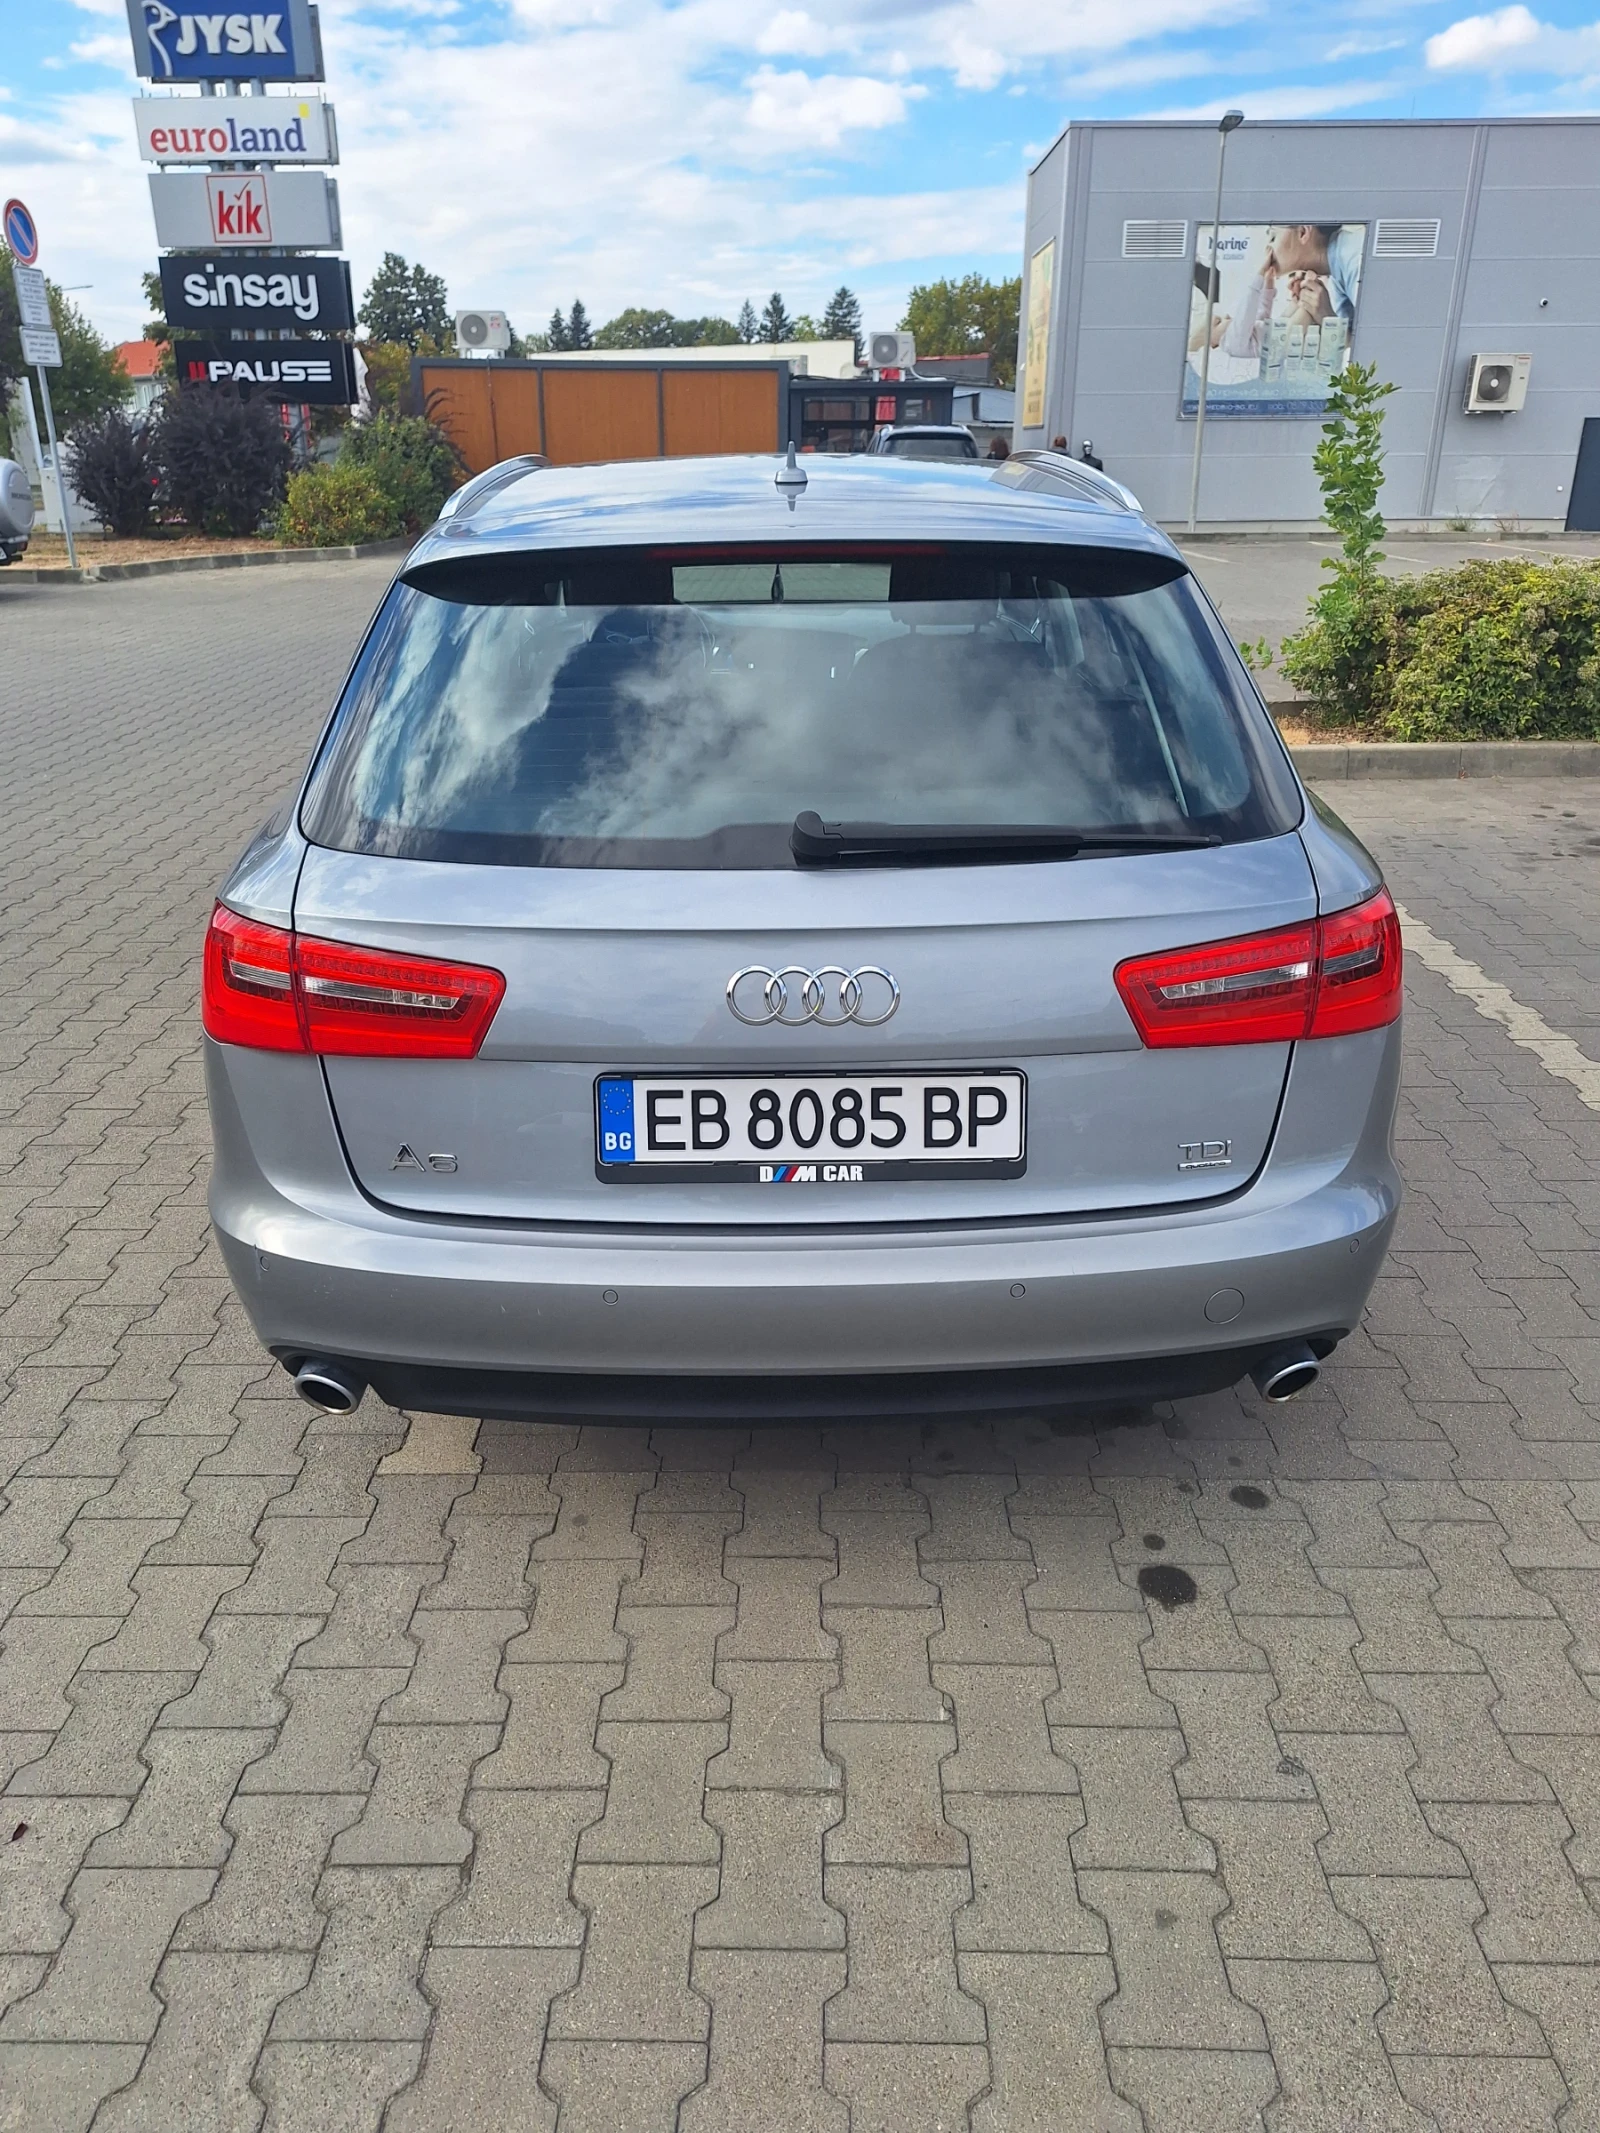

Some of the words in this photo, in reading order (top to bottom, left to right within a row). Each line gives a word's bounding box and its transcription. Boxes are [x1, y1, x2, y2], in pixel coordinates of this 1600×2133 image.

[176, 14, 287, 54] JYSK
[150, 118, 306, 153] euroland
[218, 182, 263, 234] kik
[183, 263, 320, 320] sinsay
[208, 361, 332, 382] PAUSE
[646, 1090, 730, 1150] EB
[747, 1087, 907, 1149] 8085
[923, 1086, 1008, 1148] BP
[605, 1132, 632, 1151] BG
[1178, 1139, 1232, 1160] TDI
[388, 1143, 458, 1173] A6
[823, 1165, 863, 1181] CAR
